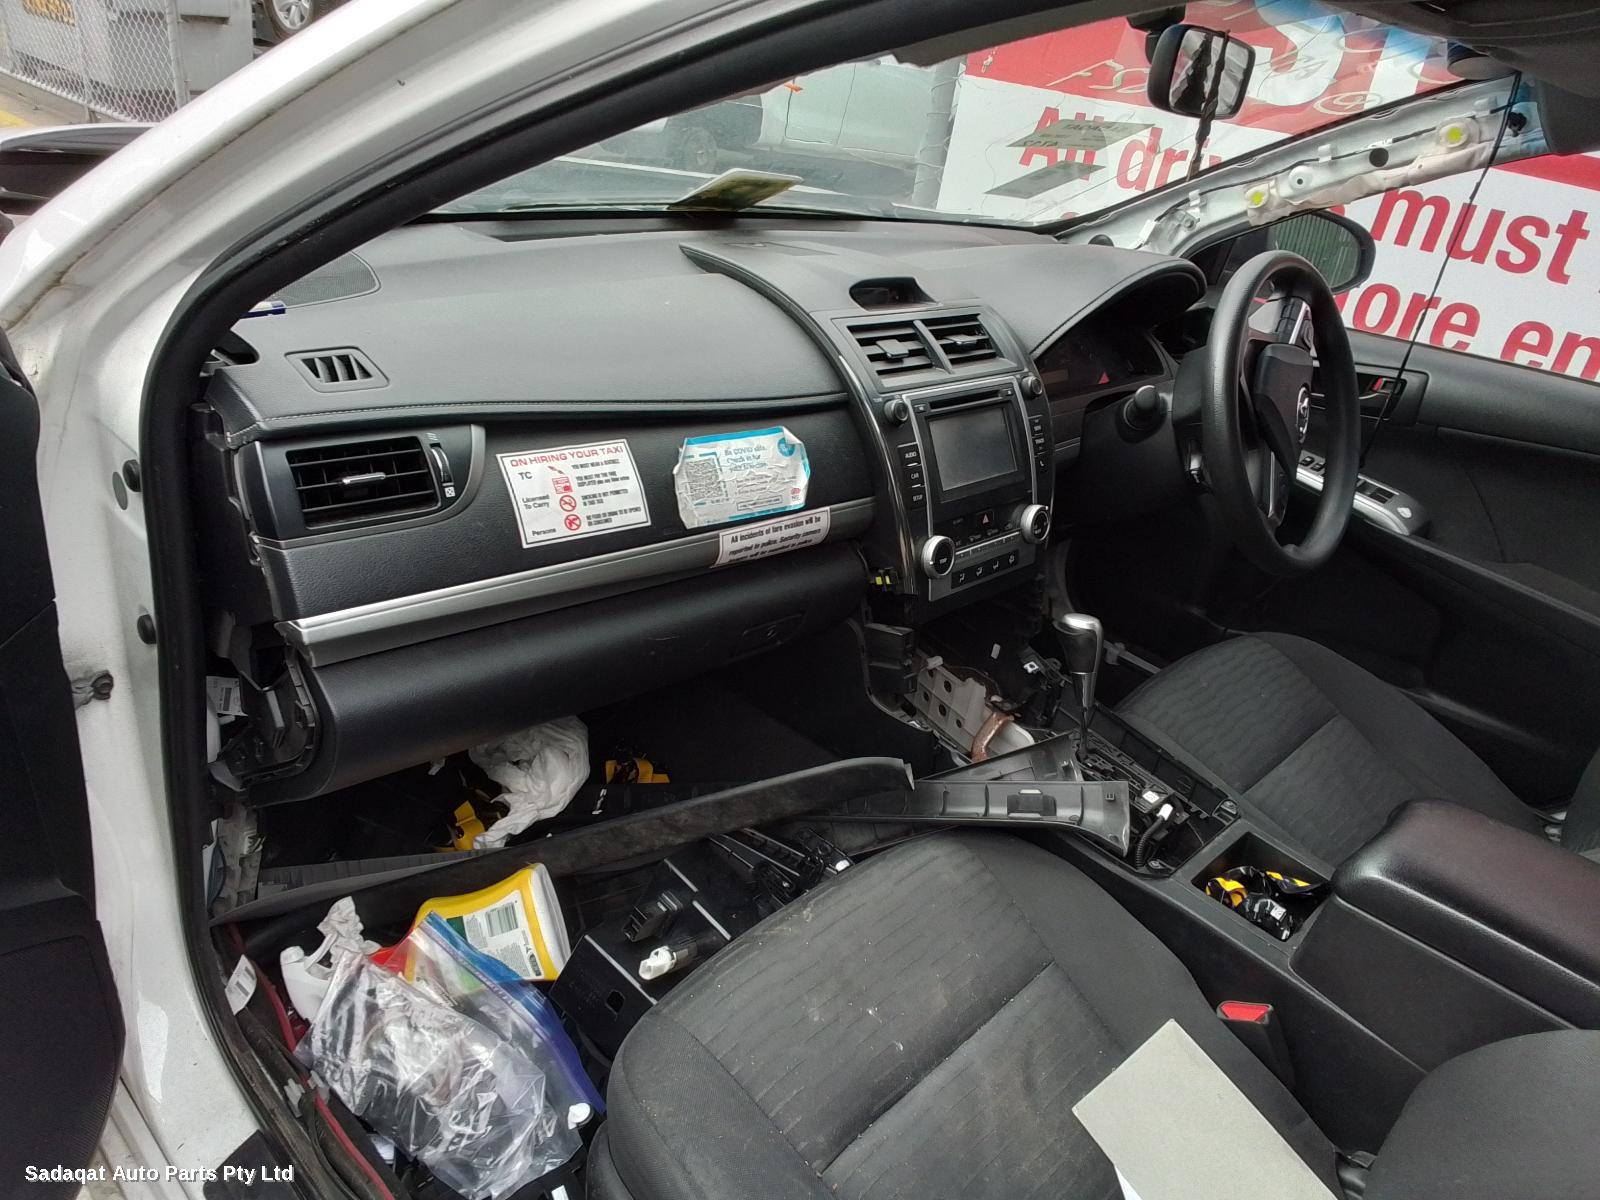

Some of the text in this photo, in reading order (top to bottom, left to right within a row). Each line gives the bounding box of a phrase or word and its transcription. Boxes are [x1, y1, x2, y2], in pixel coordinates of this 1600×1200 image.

[1370, 187, 1590, 285] must
[1333, 283, 1481, 351] ore
[510, 446, 624, 468] ON HIRING YOUR TAXI
[518, 471, 533, 481] TC
[522, 494, 550, 503] Licensed
[532, 502, 550, 510] Carry
[532, 528, 557, 537] Persons
[739, 530, 764, 541] incidents
[784, 520, 804, 530] evasion
[804, 517, 814, 526] will
[728, 544, 754, 556] reported
[779, 532, 802, 543] Security
